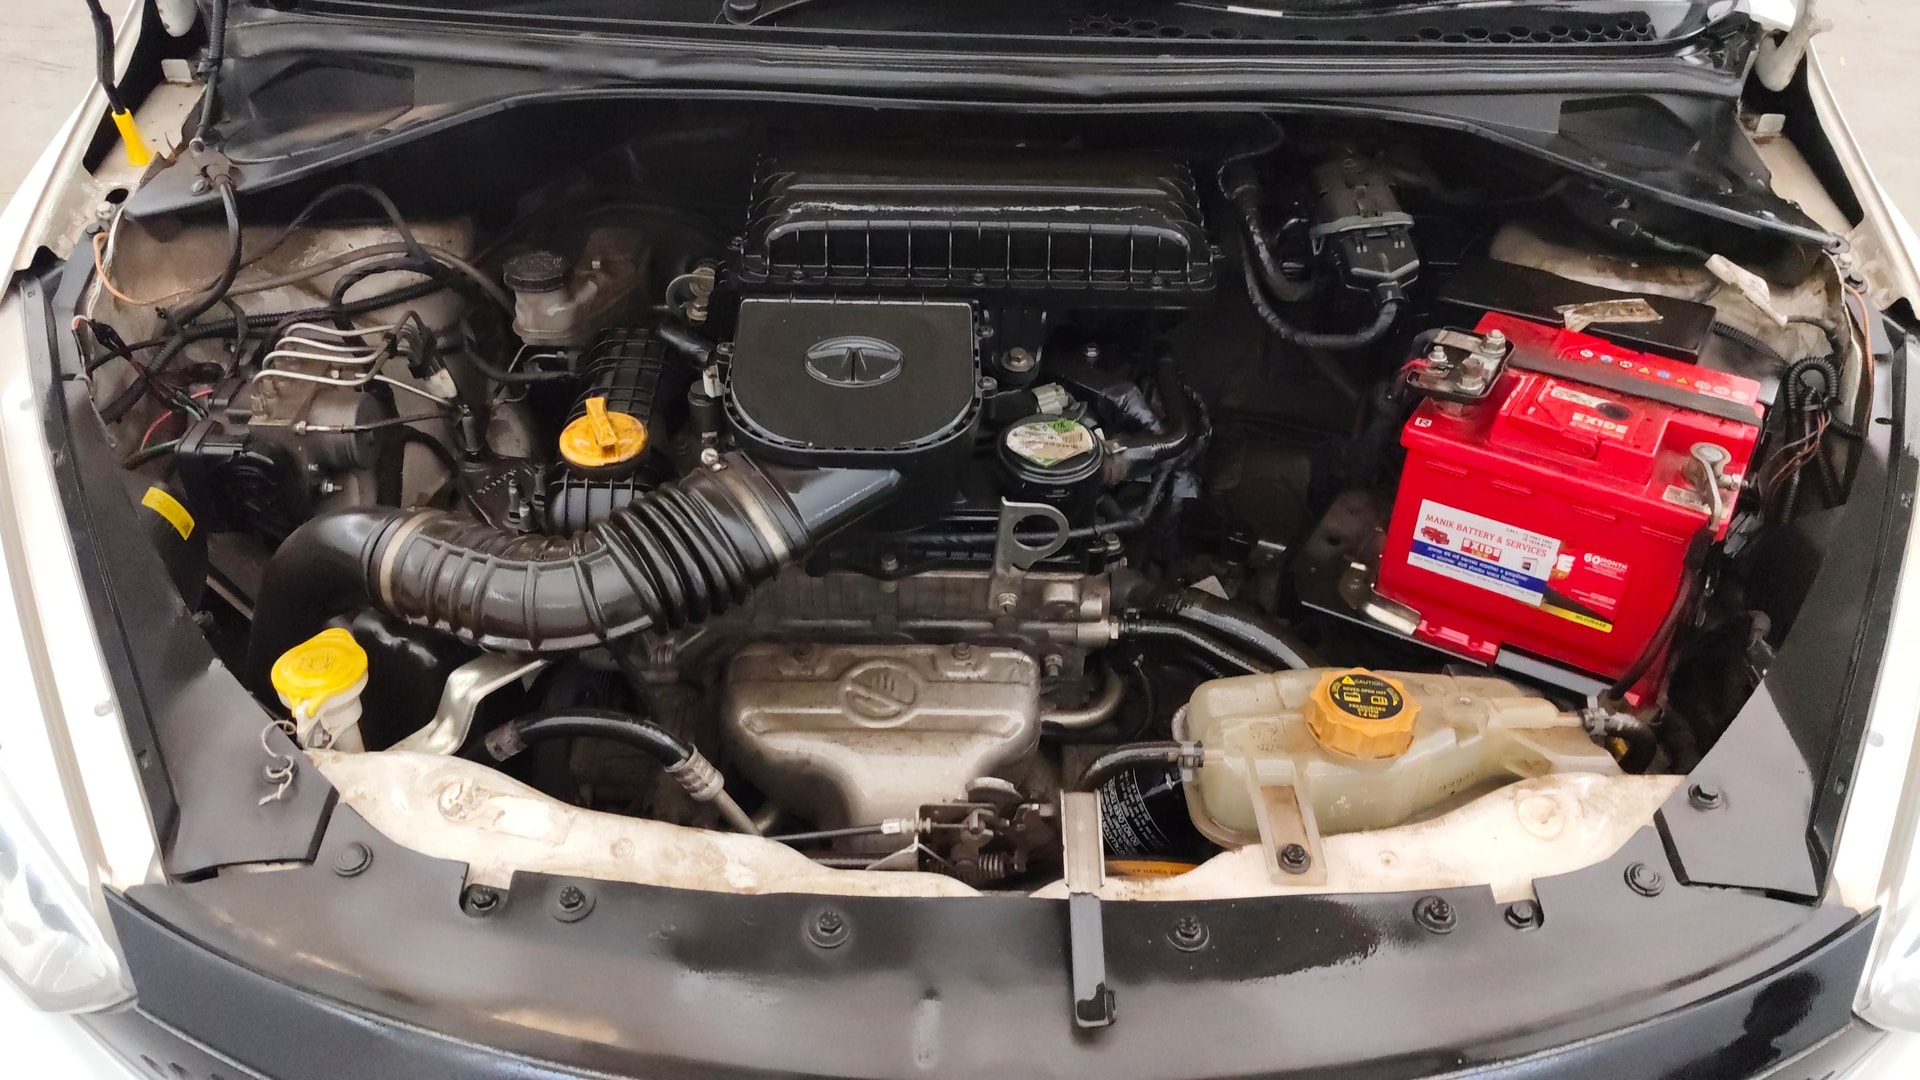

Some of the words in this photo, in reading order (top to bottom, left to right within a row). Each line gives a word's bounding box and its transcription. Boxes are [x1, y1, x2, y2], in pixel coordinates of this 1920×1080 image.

[1572, 412, 1628, 434] EXIDE
[1425, 514, 1455, 528] MANIK
[1456, 522, 1496, 541] BATTERY
[1496, 536, 1503, 544] &
[1505, 538, 1548, 557] SERVICES
[1462, 538, 1502, 557] EXIDE
[1584, 553, 1601, 565] 60
[1600, 556, 1628, 571] MONTH
[1355, 679, 1384, 687] CAUTION
[1113, 803, 1125, 824] OVER
[1121, 822, 1133, 837] NOT
[1129, 836, 1139, 847] DO
